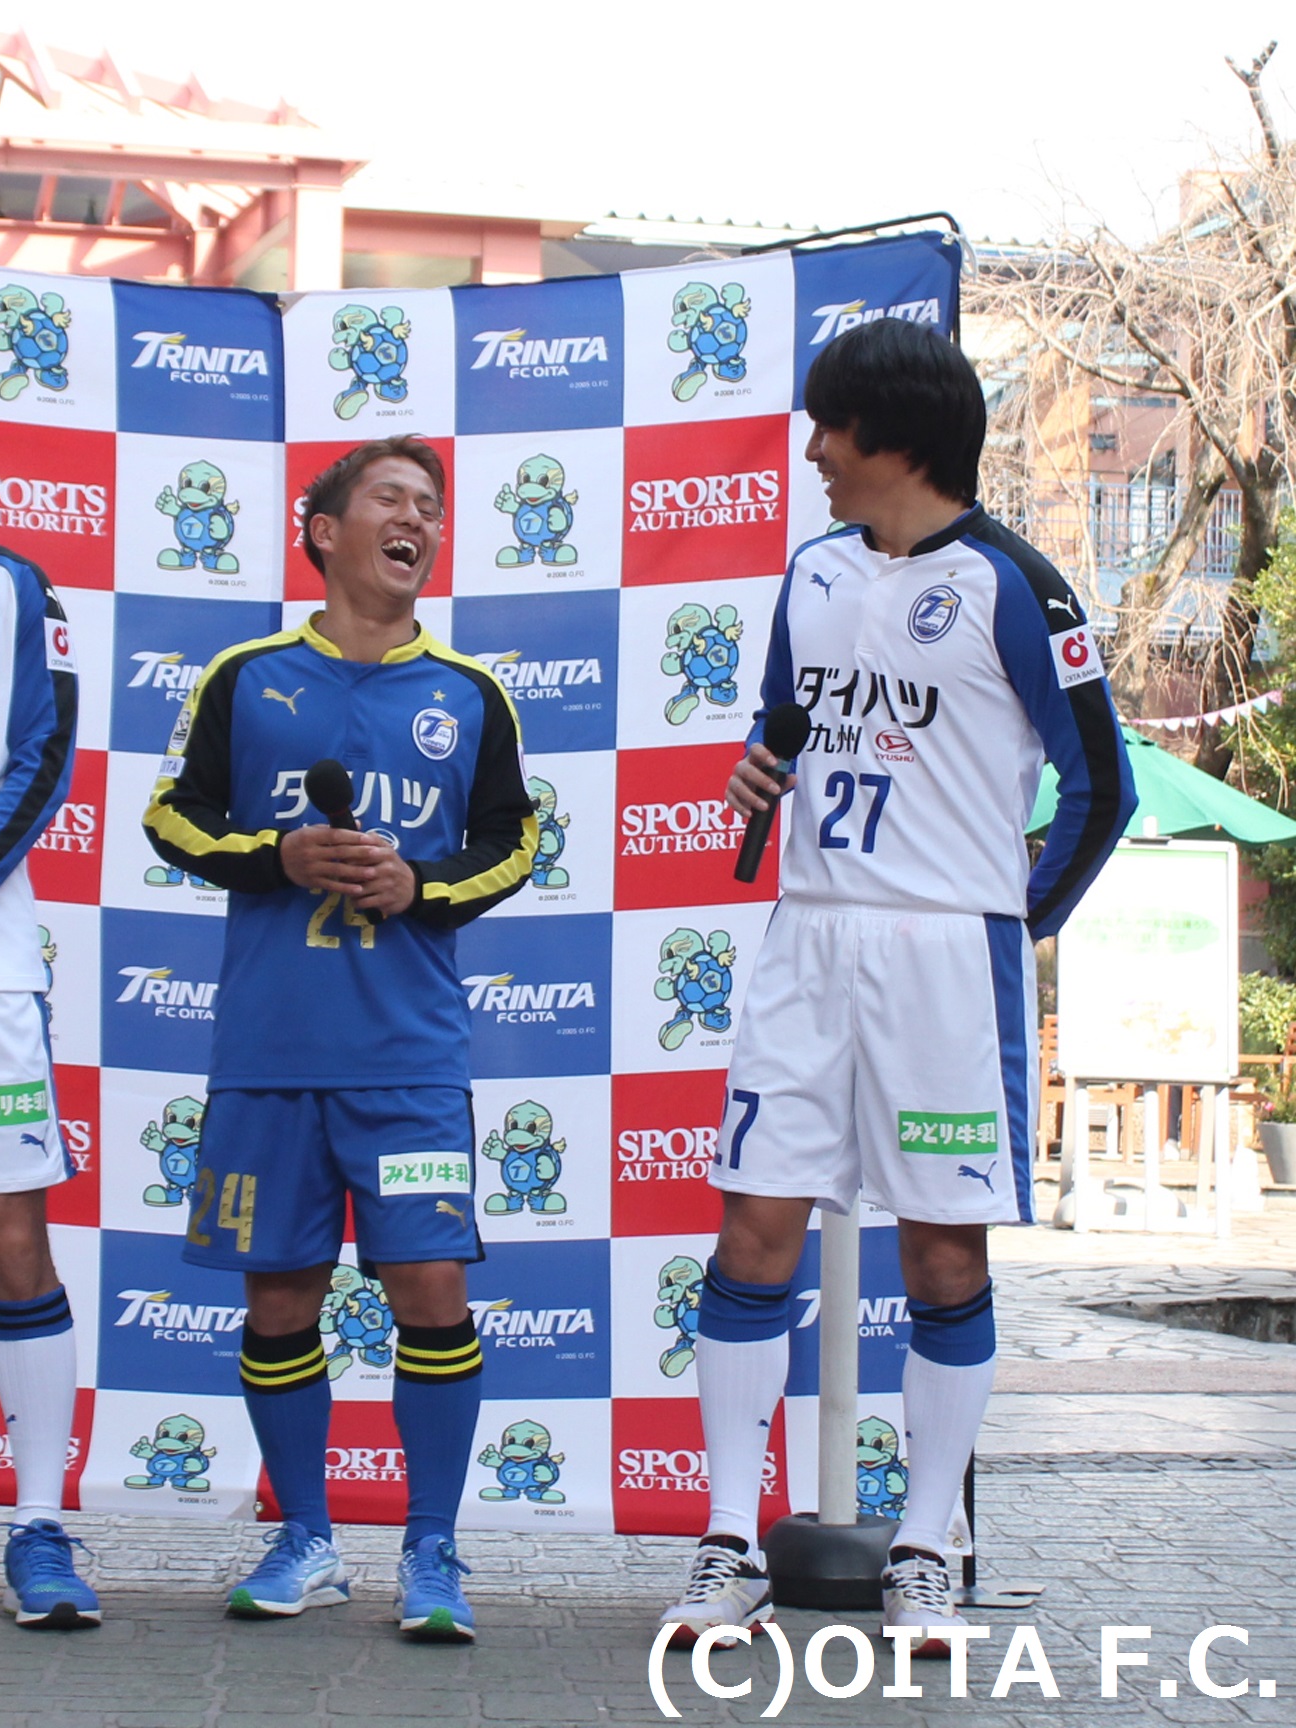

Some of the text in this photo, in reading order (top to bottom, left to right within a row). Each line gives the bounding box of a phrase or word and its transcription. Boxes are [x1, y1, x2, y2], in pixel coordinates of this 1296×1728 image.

[131, 331, 269, 375] TRINITA
[471, 328, 608, 370] TRINITA
[170, 371, 231, 386] FC OITA
[510, 365, 570, 379] FC OITA
[629, 469, 779, 513] SPORTS
[629, 502, 779, 532] AUTHORITY
[527, 687, 563, 699] OITA
[796, 667, 939, 728] ダイハツ
[807, 723, 862, 754] 九州
[271, 769, 441, 829] ダハツ
[819, 770, 892, 854] 27
[621, 800, 750, 836] SPORT
[621, 831, 746, 856] AUTHORIT
[115, 966, 219, 1008] TRINI
[460, 972, 596, 1011] TRINITA
[155, 1006, 215, 1021] FC OITA
[497, 1011, 557, 1023] FC OITA
[617, 1127, 718, 1163] SPOR
[714, 1088, 760, 1170] 7
[617, 1160, 712, 1182] AUTHO
[186, 1167, 257, 1253] 24
[153, 1330, 214, 1344] FC OITA
[495, 1335, 556, 1348] FC OITA
[325, 1447, 405, 1470] ORT
